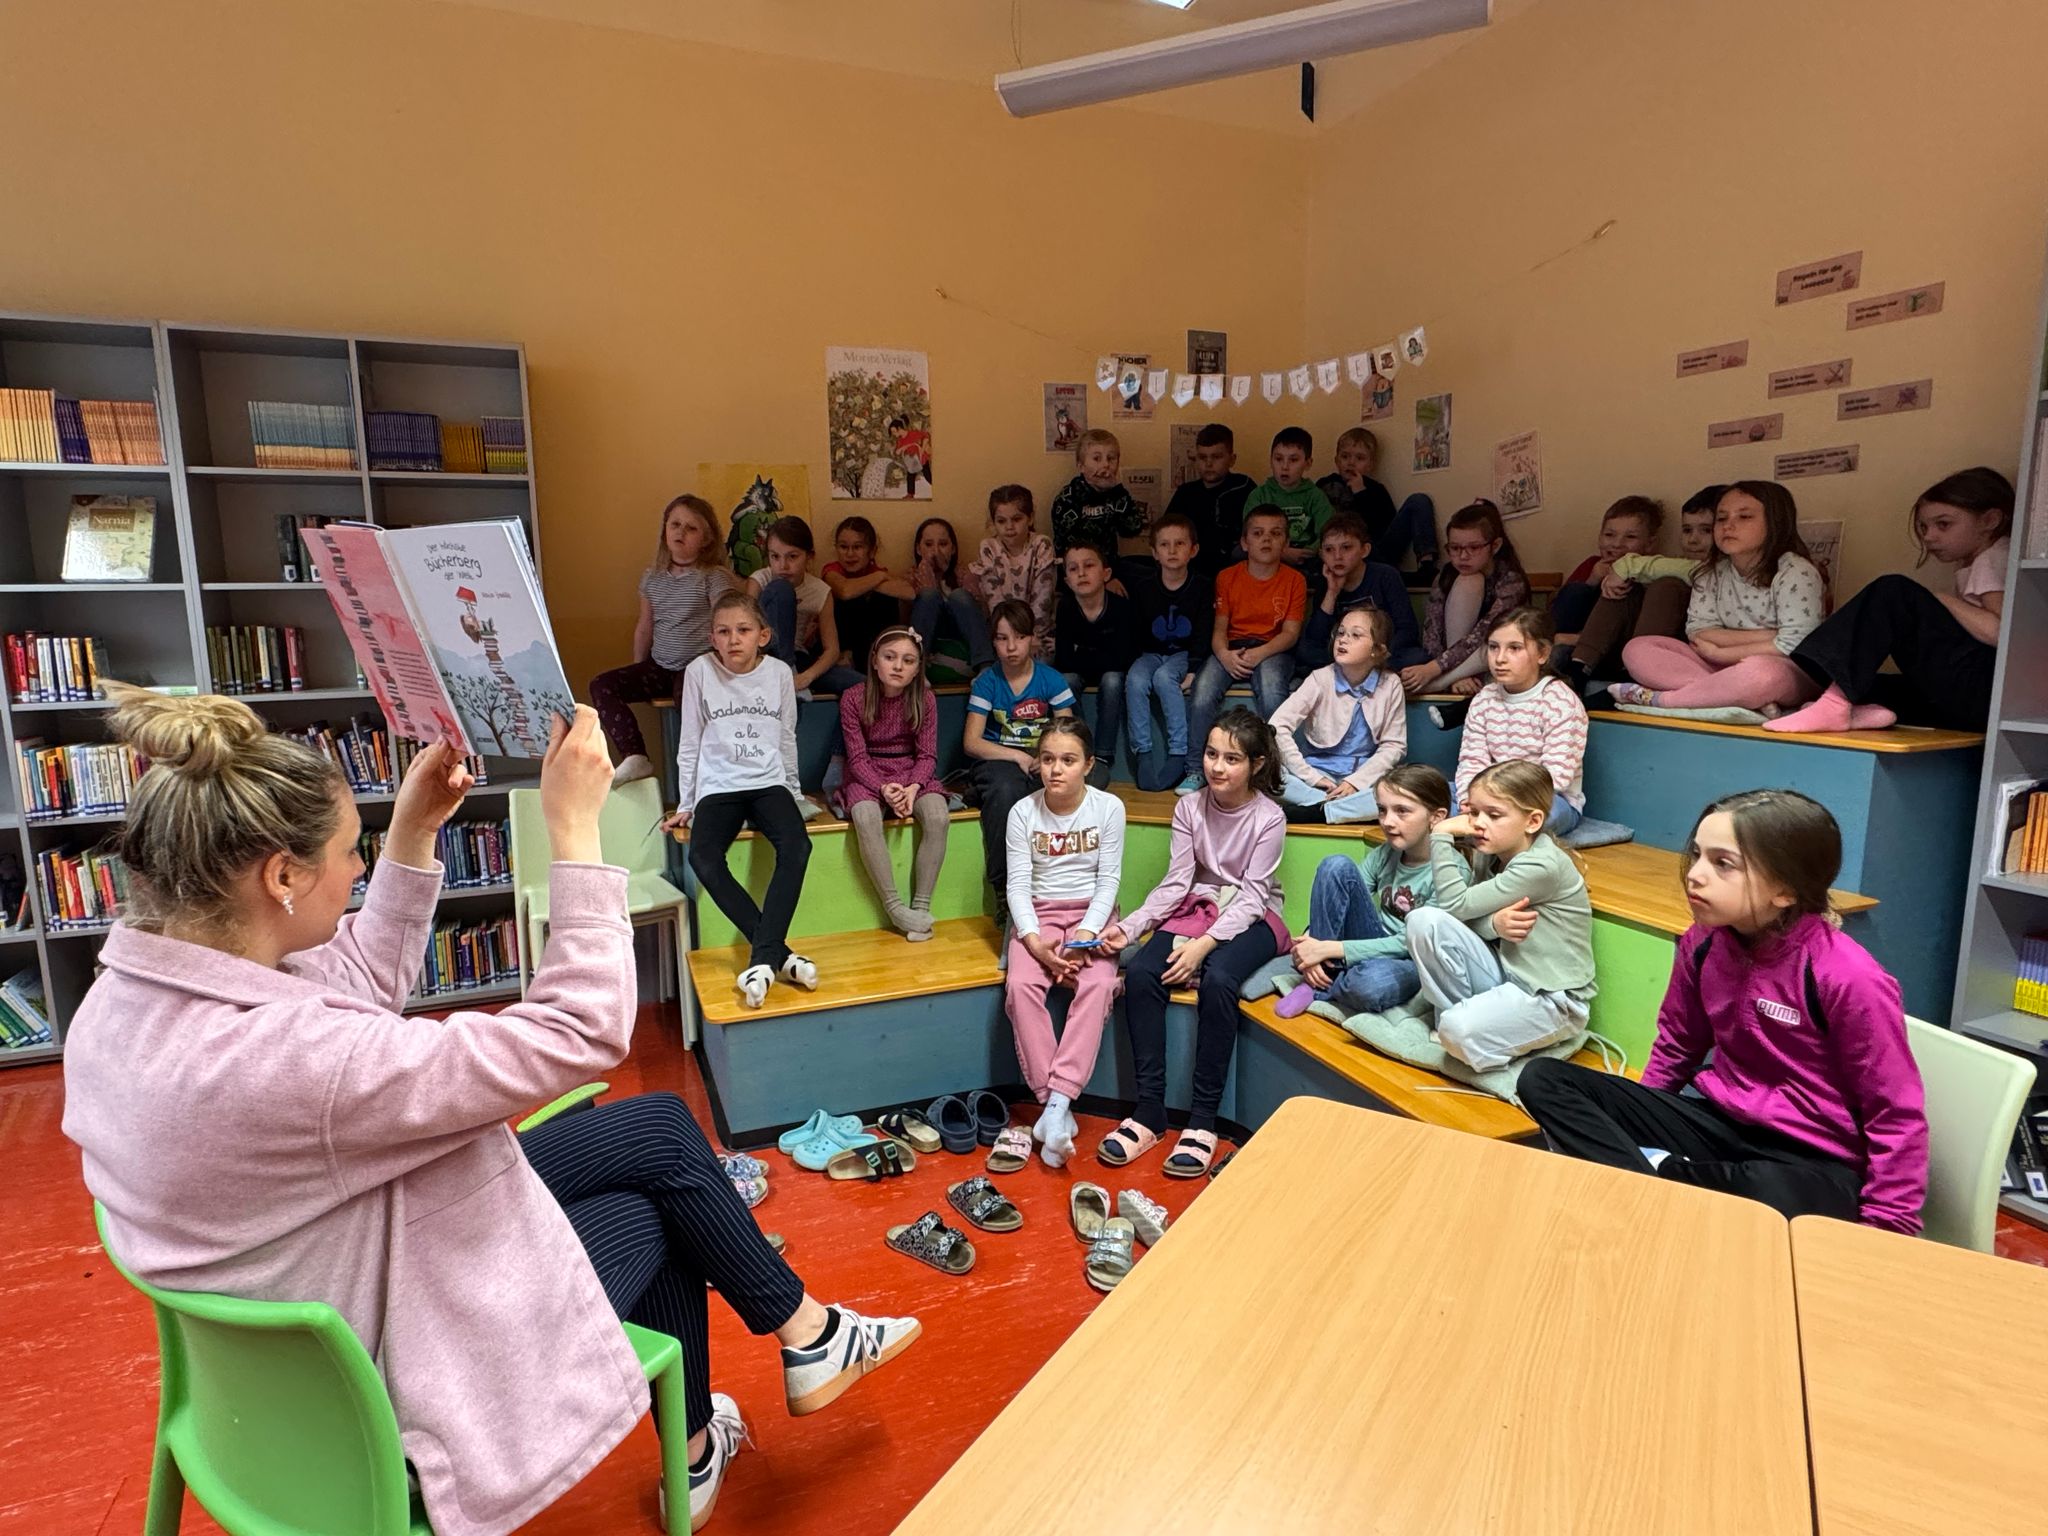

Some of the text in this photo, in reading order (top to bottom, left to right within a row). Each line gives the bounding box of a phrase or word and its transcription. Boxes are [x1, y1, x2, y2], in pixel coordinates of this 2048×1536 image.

[880, 354, 913, 368] Verlag
[93, 515, 131, 525] Narnia
[423, 555, 483, 579] Bücherberg
[747, 723, 761, 738] la
[1758, 1000, 1799, 1023] PUMA
